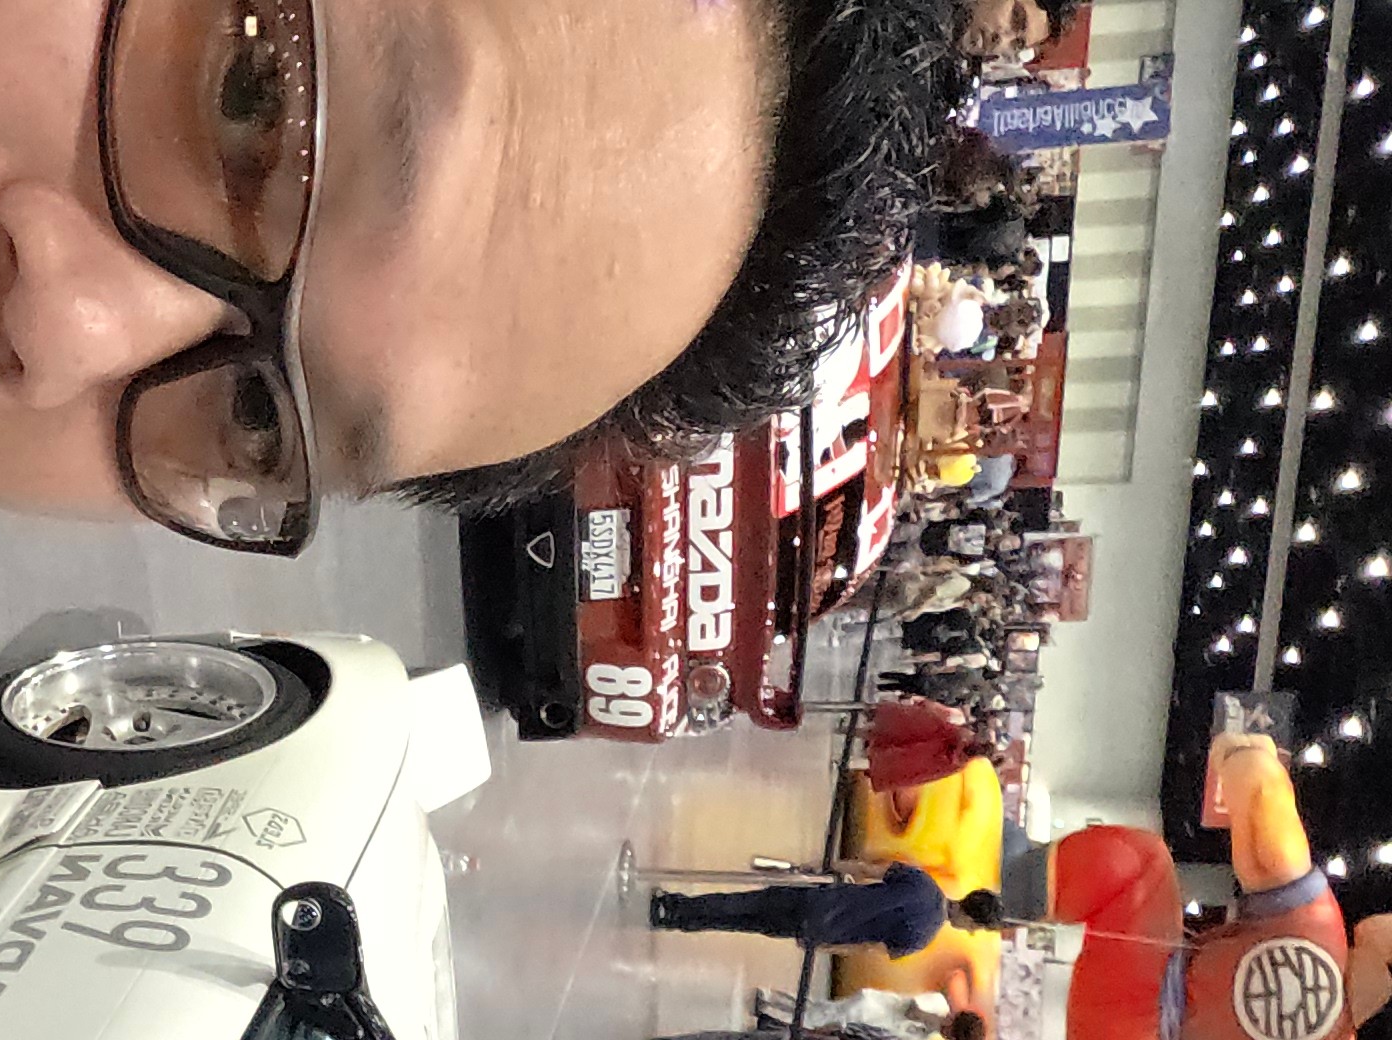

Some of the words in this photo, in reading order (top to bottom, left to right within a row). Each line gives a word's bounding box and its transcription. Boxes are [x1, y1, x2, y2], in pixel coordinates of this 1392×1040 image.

[590, 514, 615, 594] 5SDX417
[660, 464, 681, 632] SHANGHAI
[585, 663, 653, 727] 89
[61, 855, 232, 952] 339
